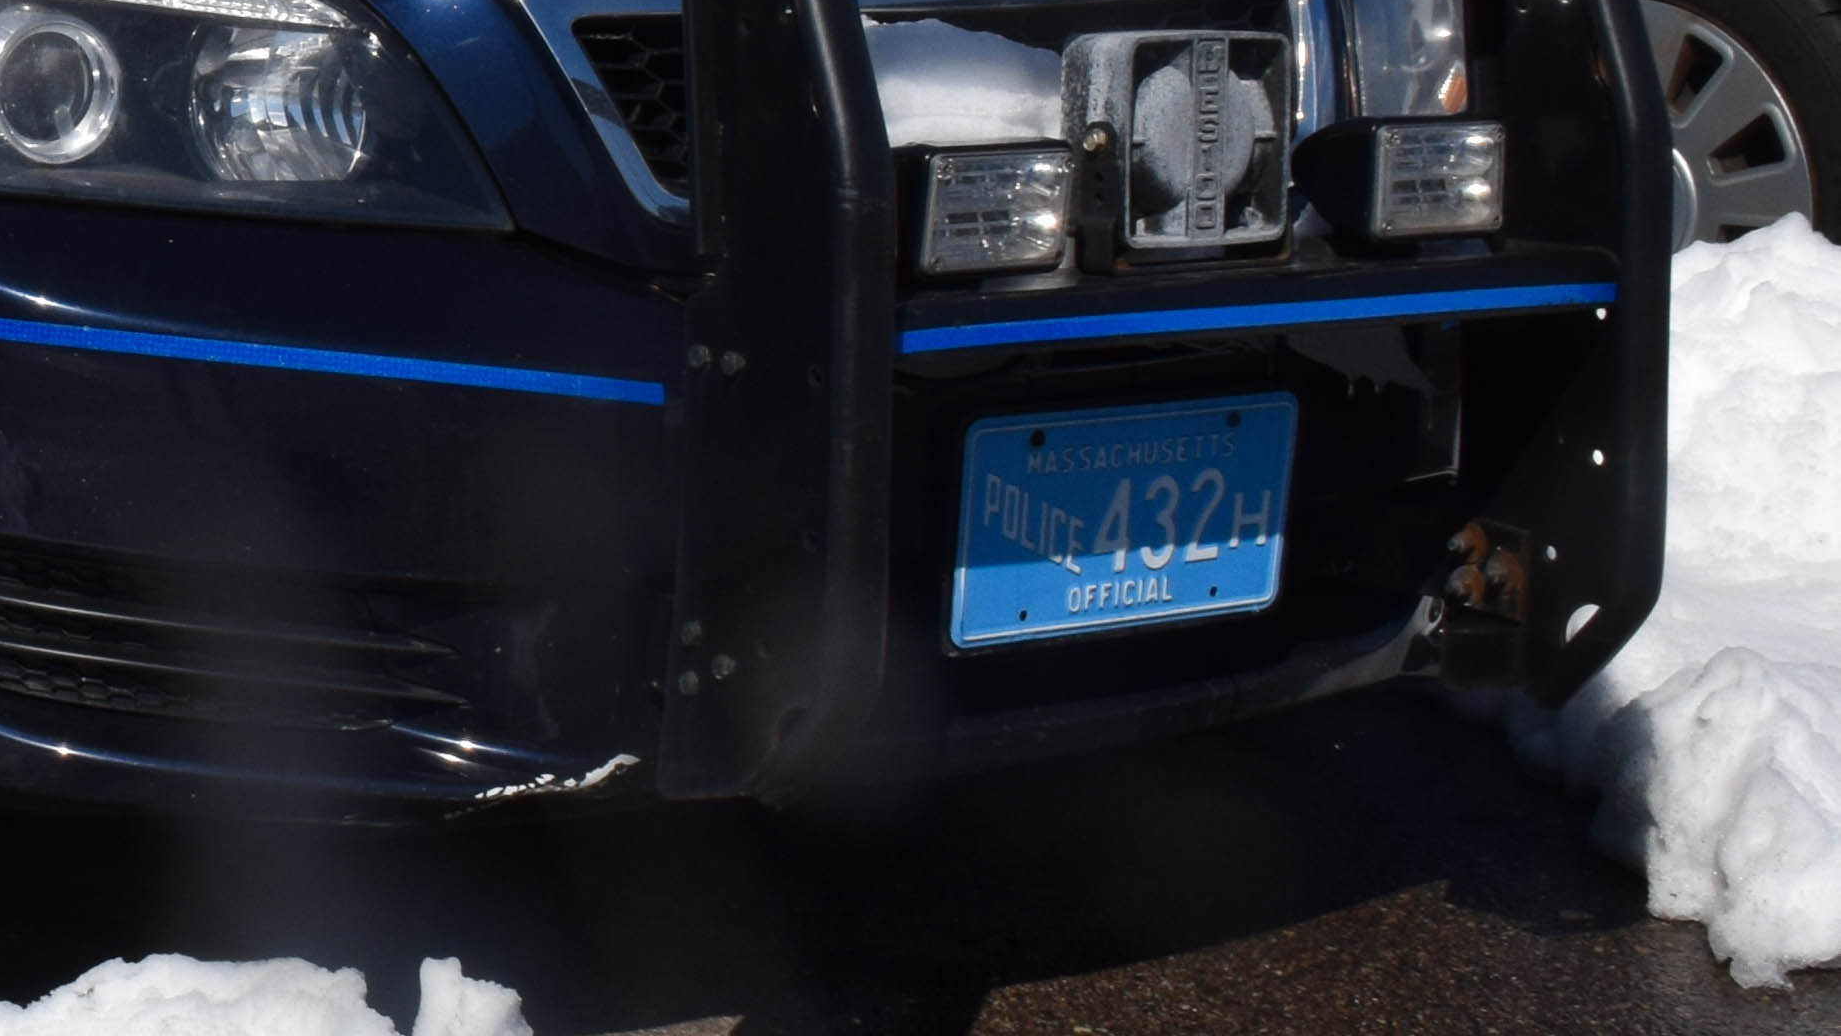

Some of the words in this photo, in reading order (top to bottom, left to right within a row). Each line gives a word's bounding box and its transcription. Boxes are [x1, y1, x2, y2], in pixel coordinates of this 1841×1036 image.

[1027, 431, 1237, 475] MASSACHUSETTS
[983, 472, 1087, 576] POLICE
[1067, 576, 1174, 614] OFFICIAL
